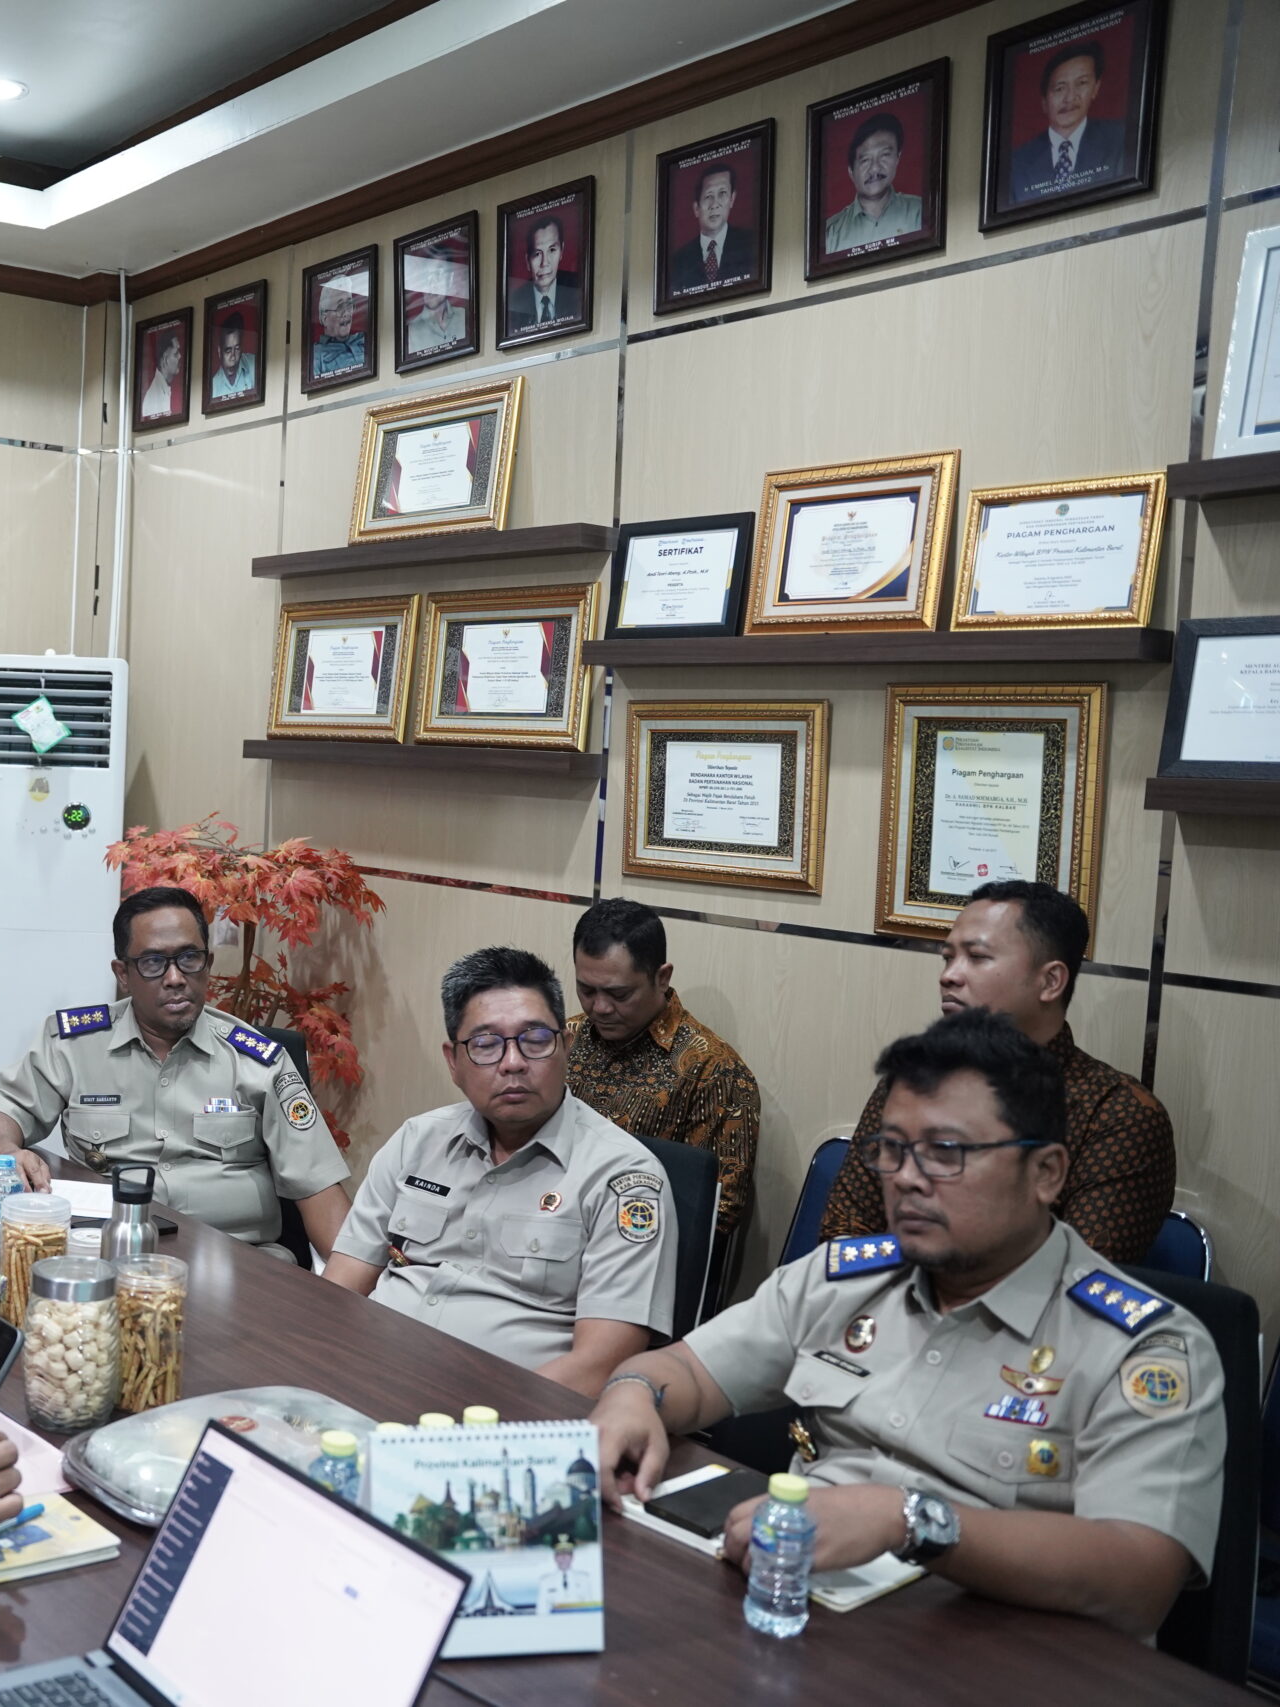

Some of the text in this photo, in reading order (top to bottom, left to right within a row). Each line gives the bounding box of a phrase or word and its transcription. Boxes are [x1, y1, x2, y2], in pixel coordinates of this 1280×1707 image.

[1006, 524, 1116, 539] PIAGAM PENGHARGAAN
[658, 546, 704, 557] SERTIFIKAT
[952, 768, 1024, 780] Piagam Penghargaan
[414, 1180, 440, 1192] KAINDA
